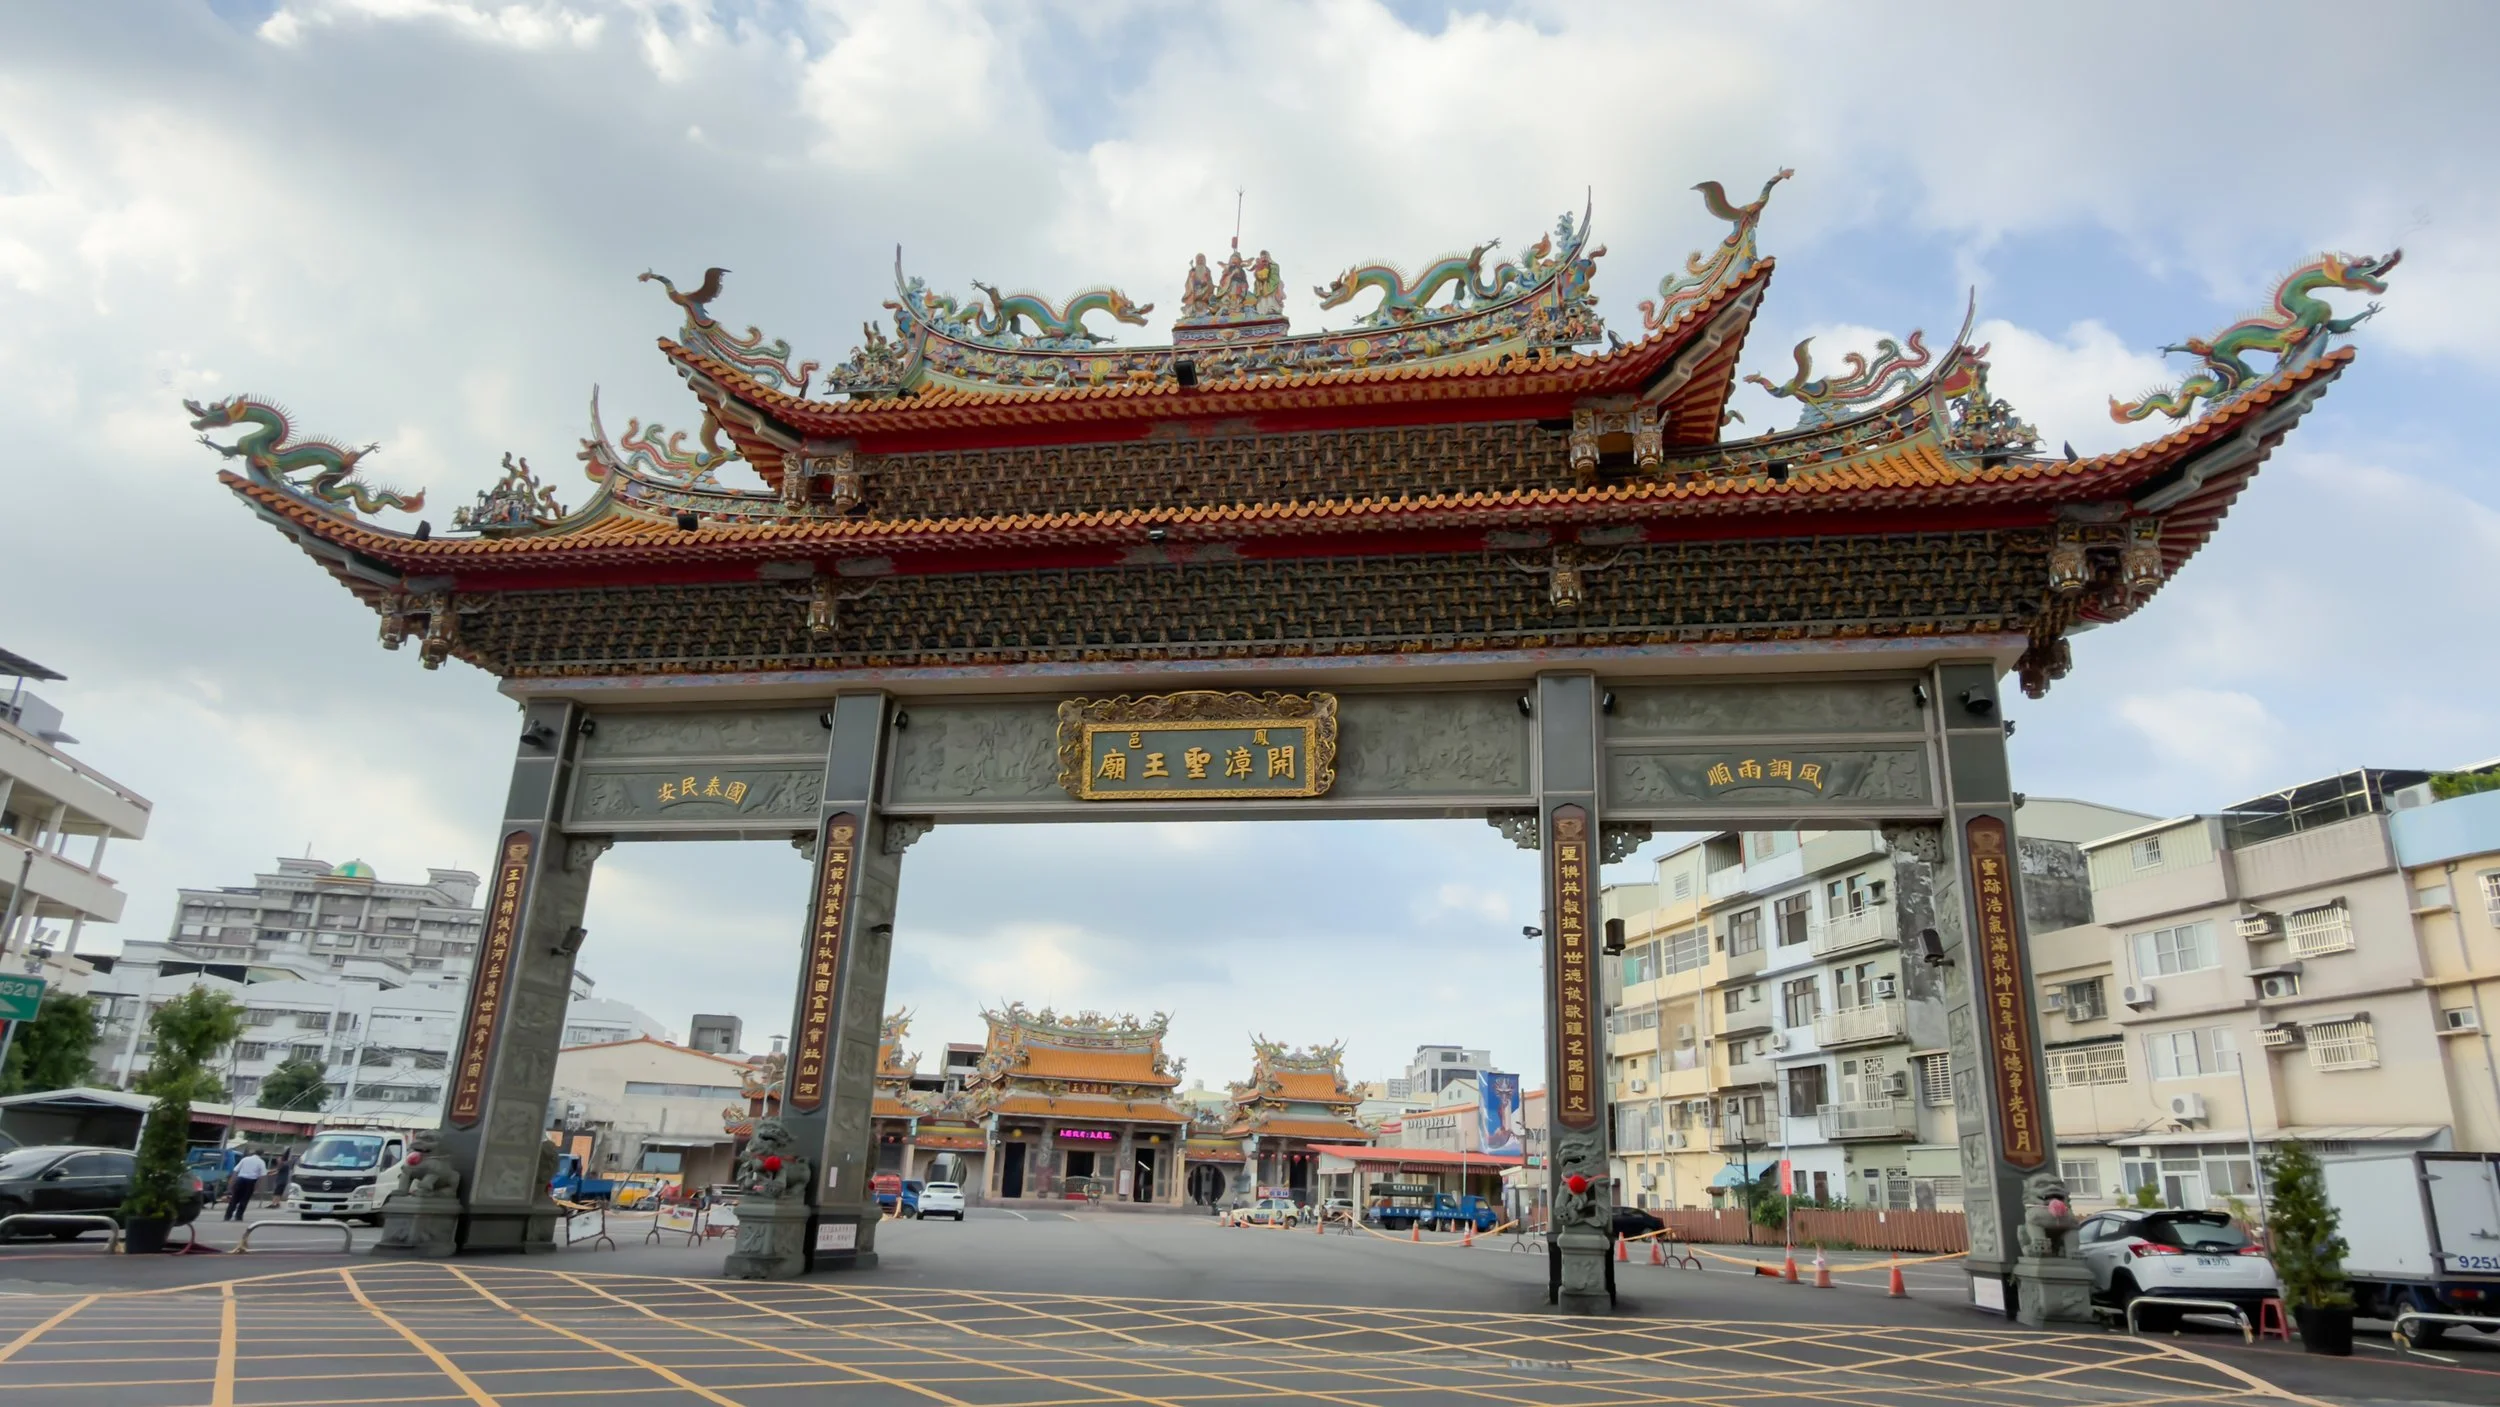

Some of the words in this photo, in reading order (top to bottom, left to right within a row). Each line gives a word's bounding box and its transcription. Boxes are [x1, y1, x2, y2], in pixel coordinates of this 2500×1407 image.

[657, 775, 748, 804] 國泰民安
[1706, 758, 1823, 791] 風調雨順
